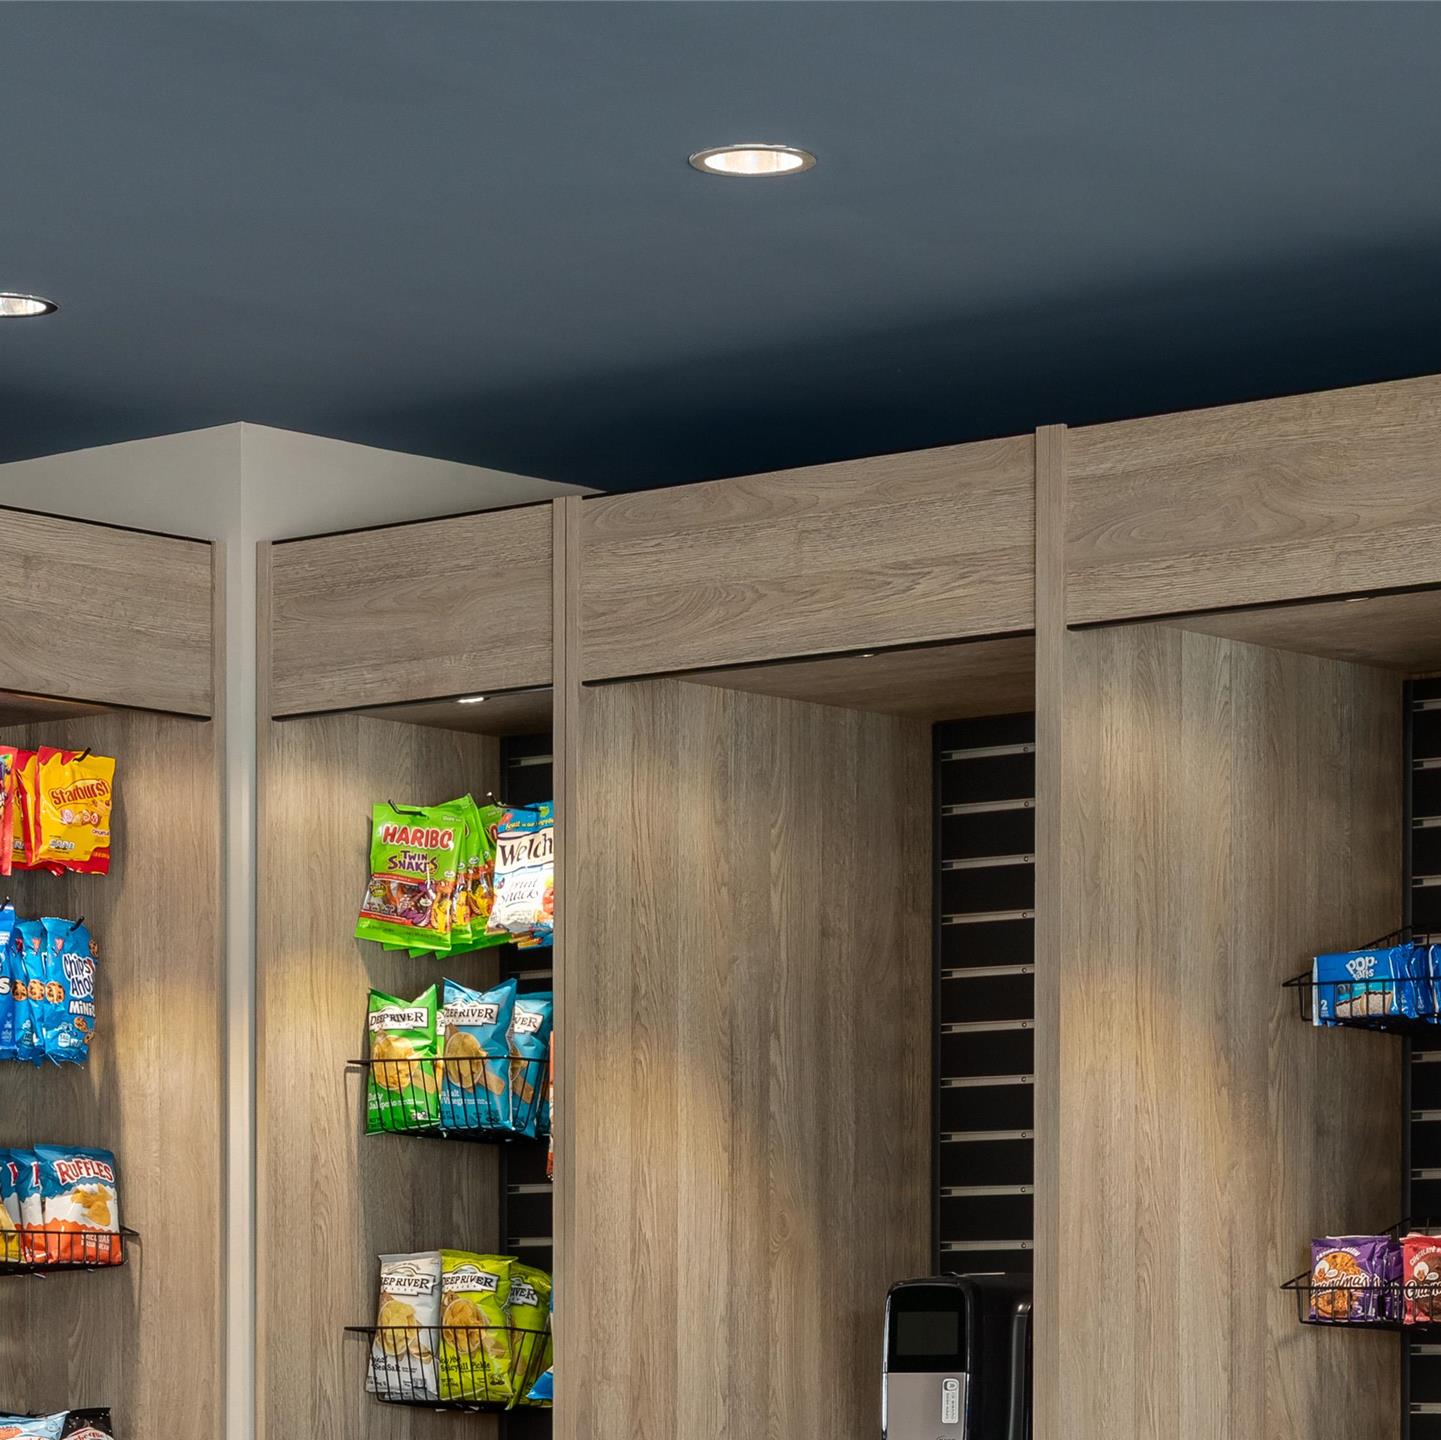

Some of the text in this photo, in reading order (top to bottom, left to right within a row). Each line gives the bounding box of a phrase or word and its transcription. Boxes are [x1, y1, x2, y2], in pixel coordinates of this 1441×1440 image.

[50, 781, 109, 805] Starburst
[383, 825, 454, 849] HARIBO
[400, 851, 428, 861] TWIN
[1321, 1001, 1327, 1010] 2
[370, 1011, 424, 1026] DEEP RIVER
[459, 1008, 494, 1019] RIVER
[54, 1160, 114, 1185] RUFFLES
[396, 1278, 430, 1289] RIVER
[461, 1276, 494, 1287] RIVER
